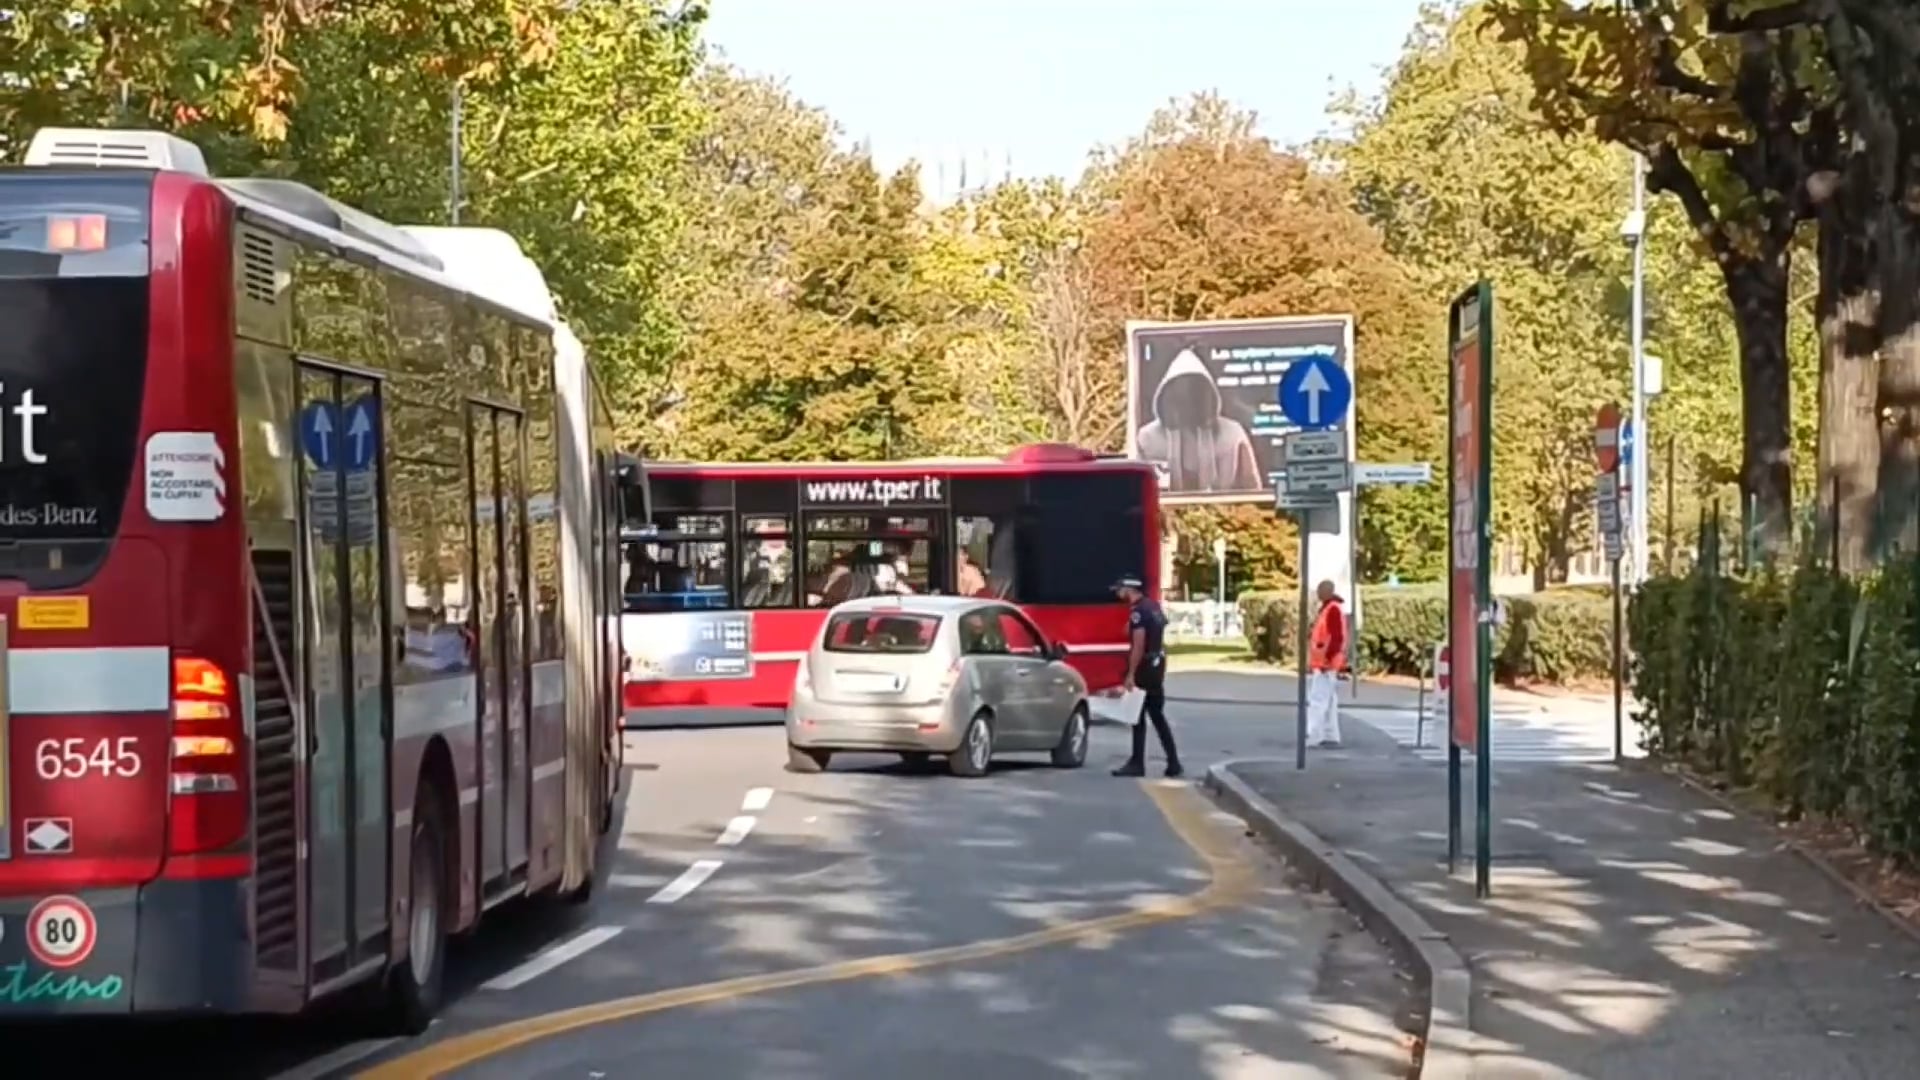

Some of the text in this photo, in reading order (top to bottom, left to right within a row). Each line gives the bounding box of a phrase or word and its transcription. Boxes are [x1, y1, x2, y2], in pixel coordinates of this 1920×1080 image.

[807, 475, 942, 507] www.tper.it
[35, 736, 141, 780] 6545
[46, 917, 77, 944] 80
[0, 956, 123, 1002] tano
